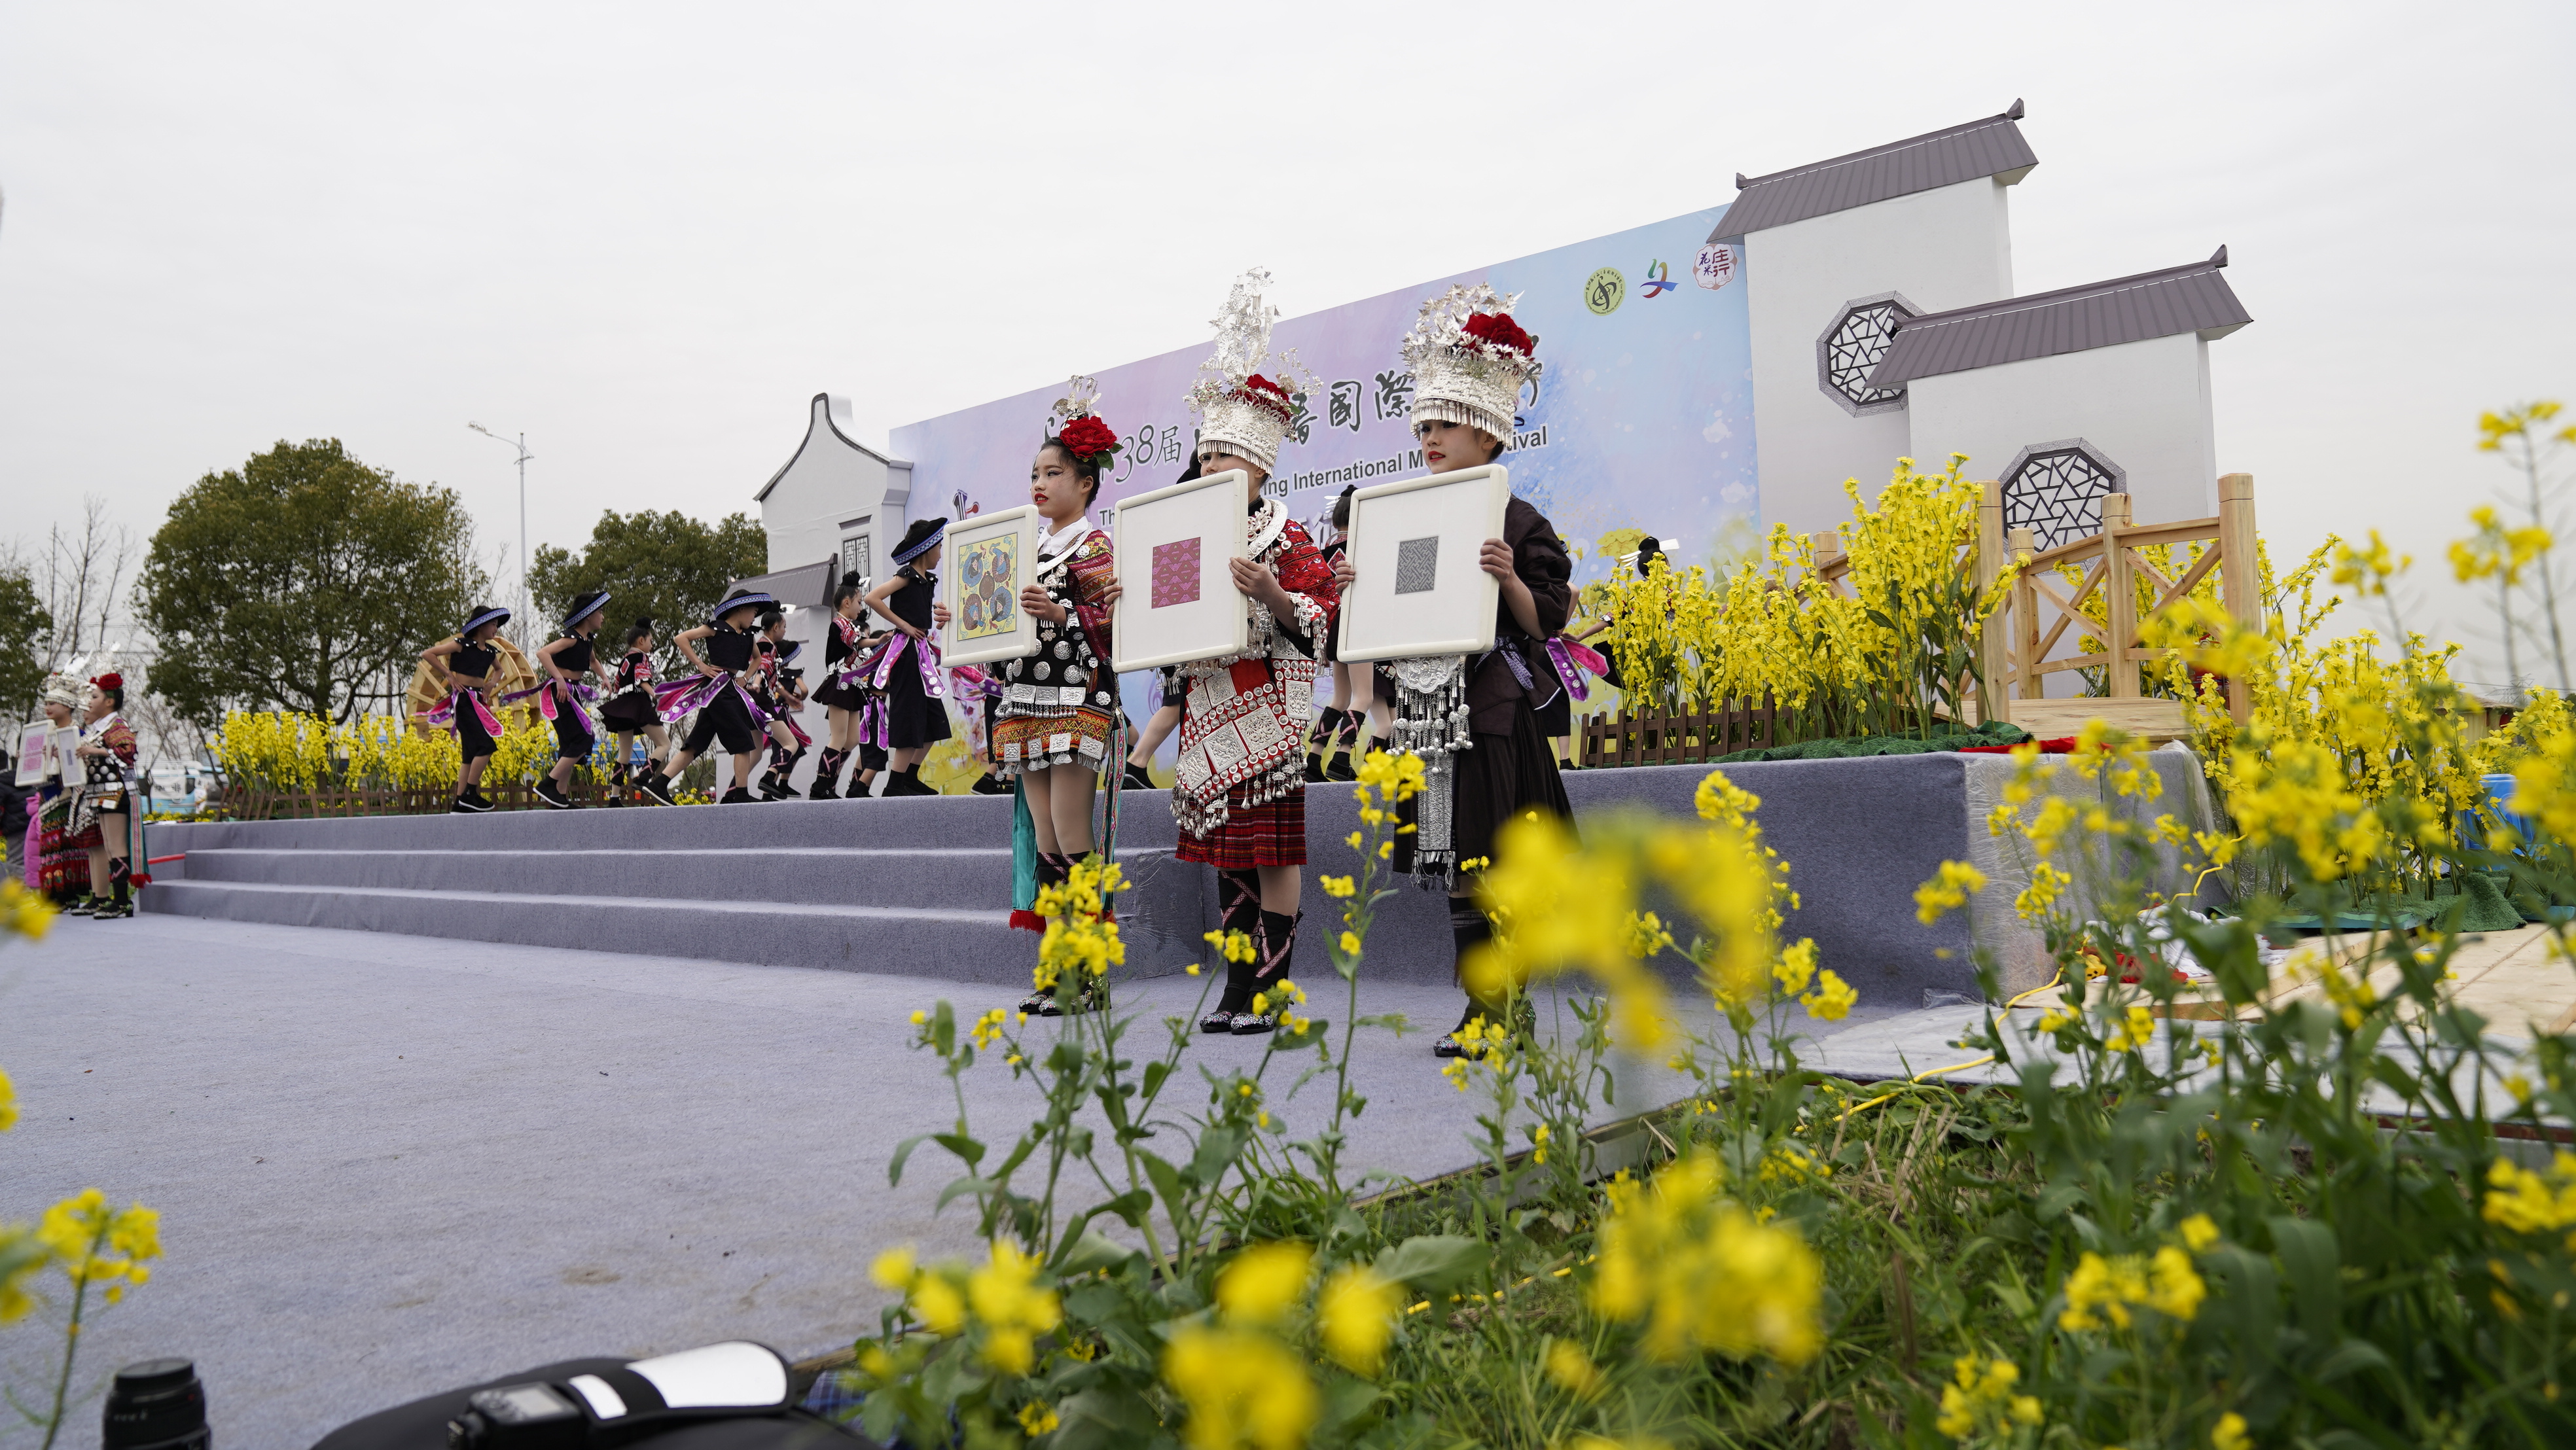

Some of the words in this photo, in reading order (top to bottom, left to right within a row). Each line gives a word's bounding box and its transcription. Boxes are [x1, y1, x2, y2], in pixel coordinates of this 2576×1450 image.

[1100, 425, 1181, 483] 38届
[1263, 478, 1289, 497] ing
[1293, 453, 1402, 491] International
